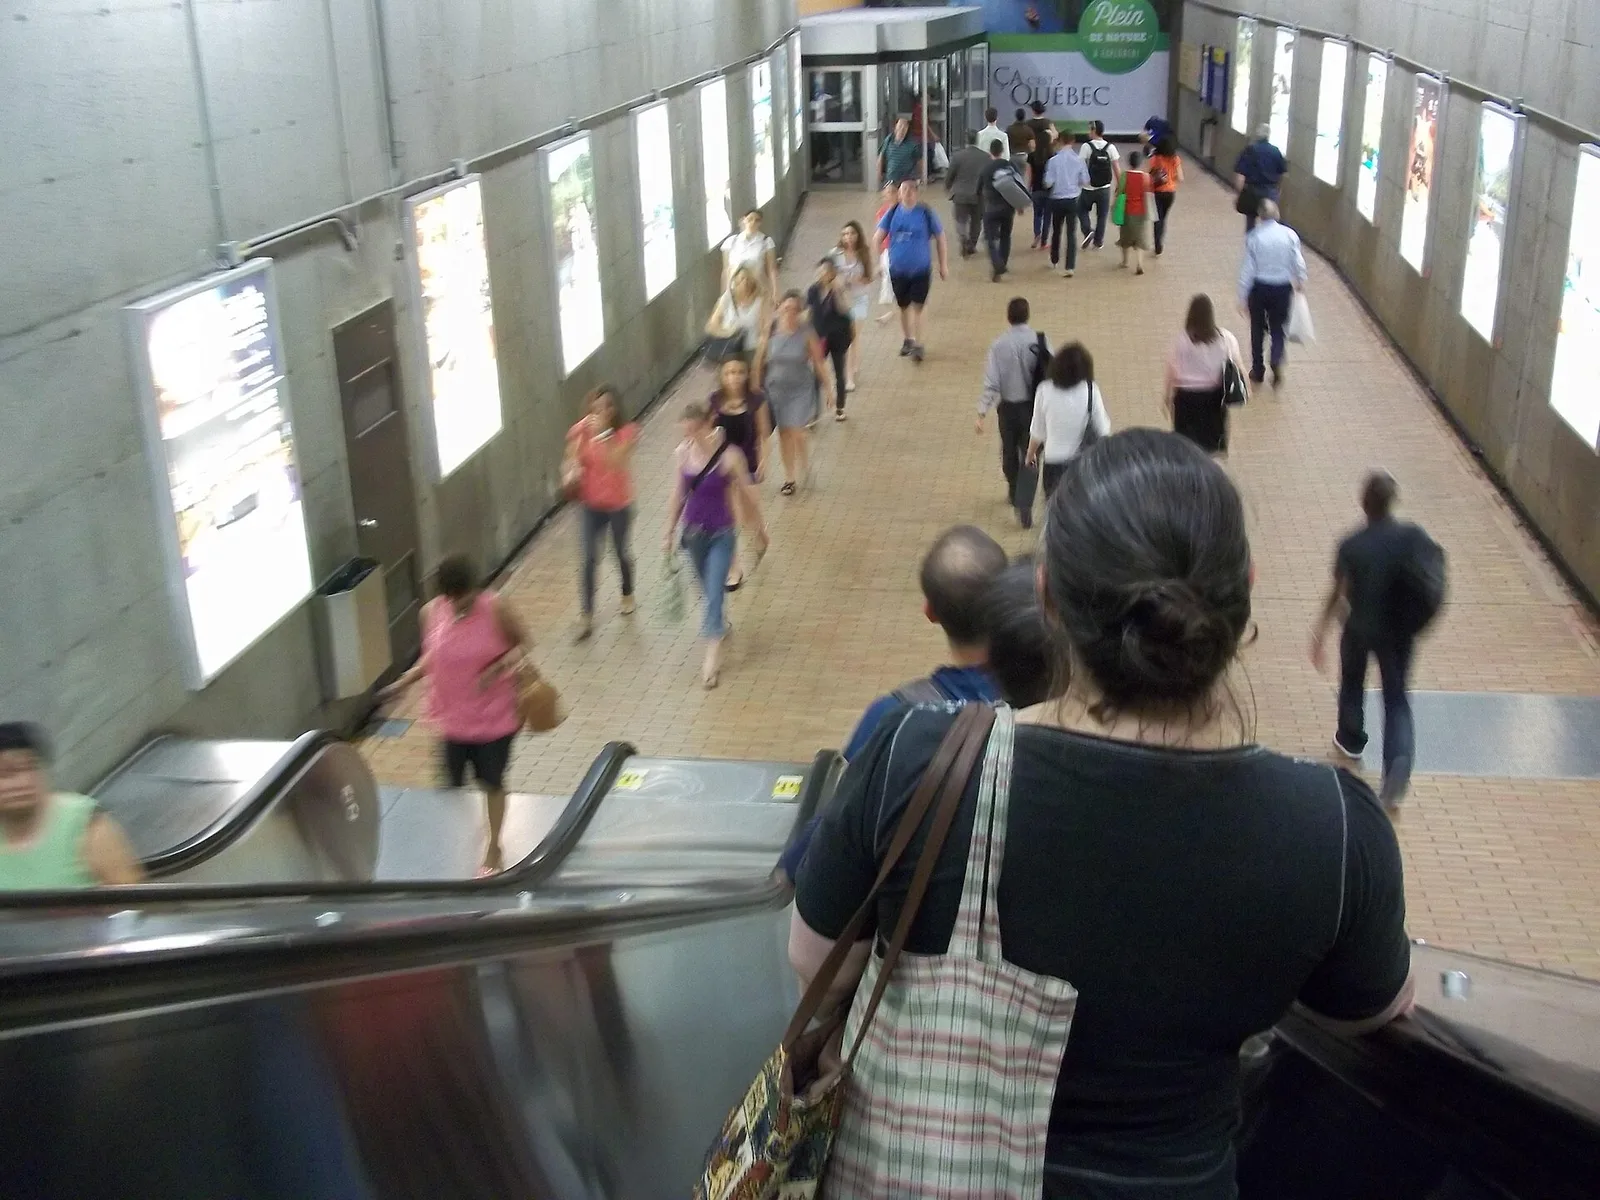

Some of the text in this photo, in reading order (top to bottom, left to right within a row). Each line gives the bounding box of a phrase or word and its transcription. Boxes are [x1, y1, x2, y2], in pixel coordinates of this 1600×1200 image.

[1092, 1, 1145, 27] Plein
[1089, 32, 1147, 42] DE NATURE
[994, 66, 1024, 91] ÇA
[1011, 82, 1110, 106] QUÉBEC
